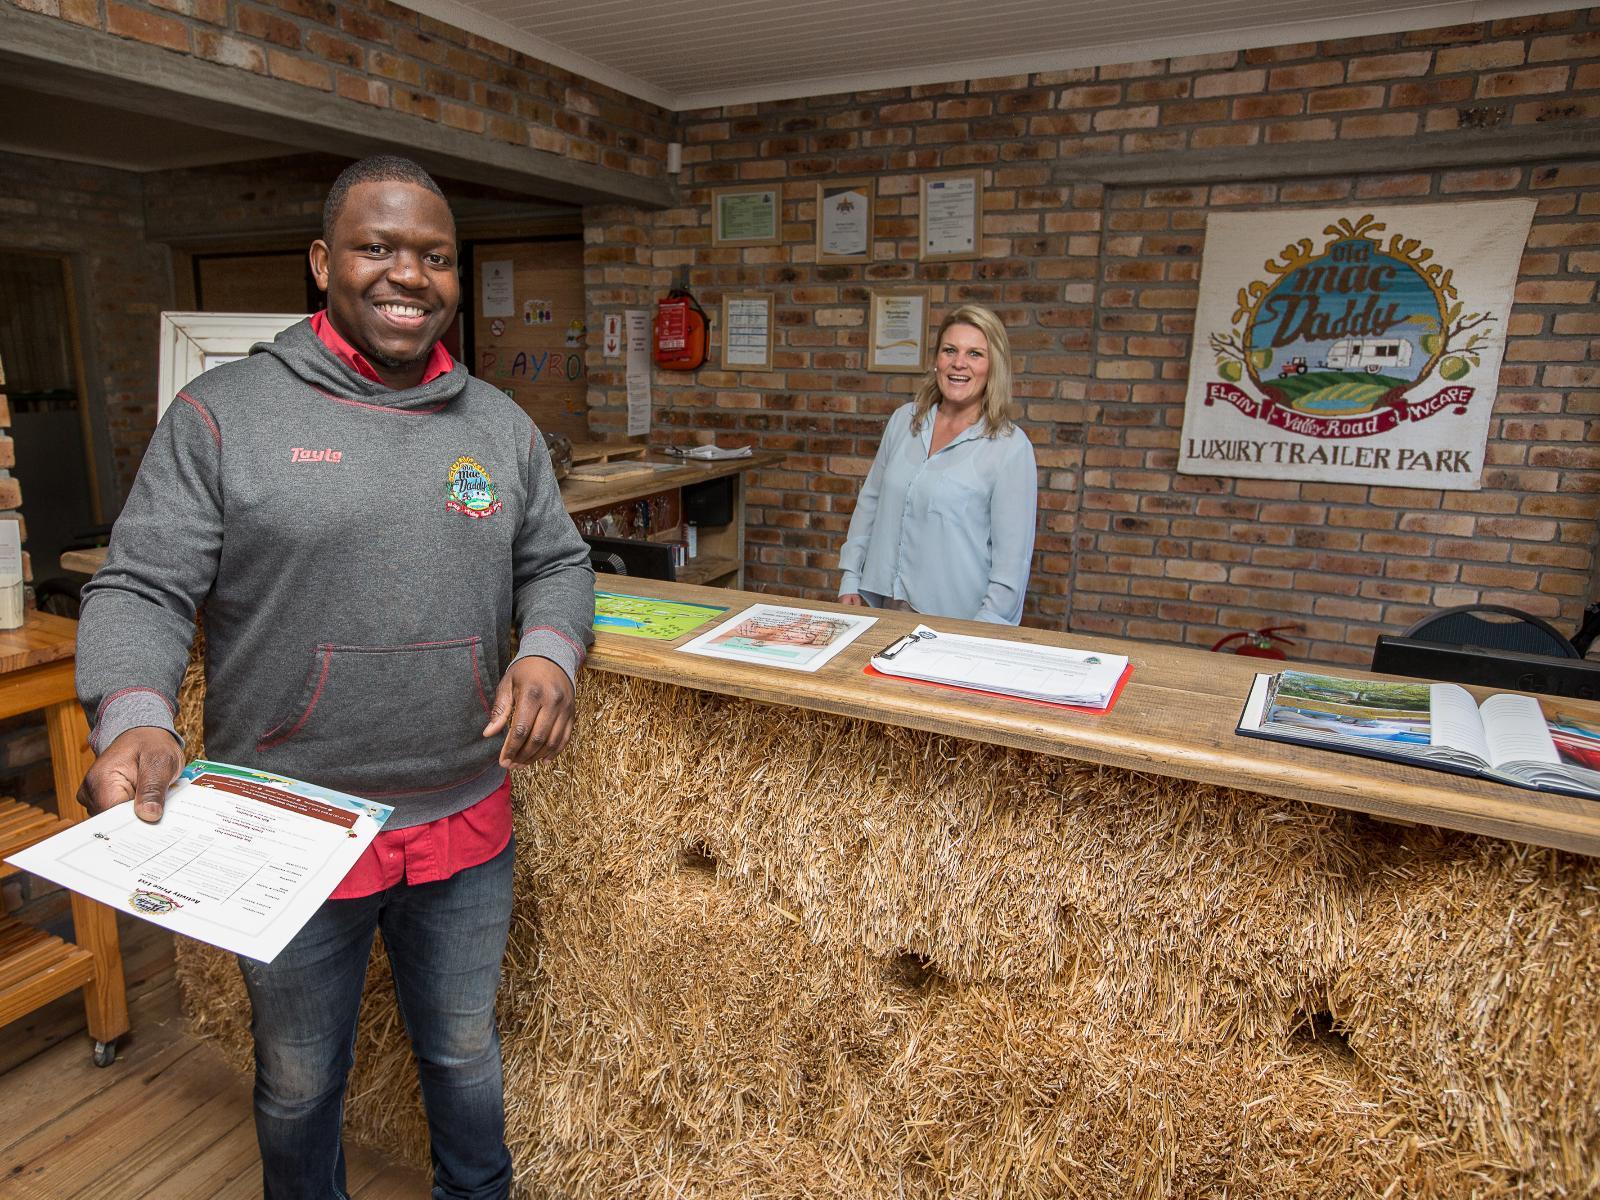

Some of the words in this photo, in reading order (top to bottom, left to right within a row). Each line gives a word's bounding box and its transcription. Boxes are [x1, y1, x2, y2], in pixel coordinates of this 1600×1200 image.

[1258, 293, 1411, 348] Daddy
[1209, 384, 1254, 414] ELGIN
[1283, 410, 1325, 437] Valley
[1323, 416, 1378, 437] Road
[1187, 438, 1268, 463] LUXURY
[1270, 440, 1390, 470] TRAILER
[1396, 447, 1474, 474] PARK
[454, 477, 487, 492] Daddy
[138, 878, 152, 886] List
[153, 884, 172, 894] Price
[173, 891, 200, 904] Activity
